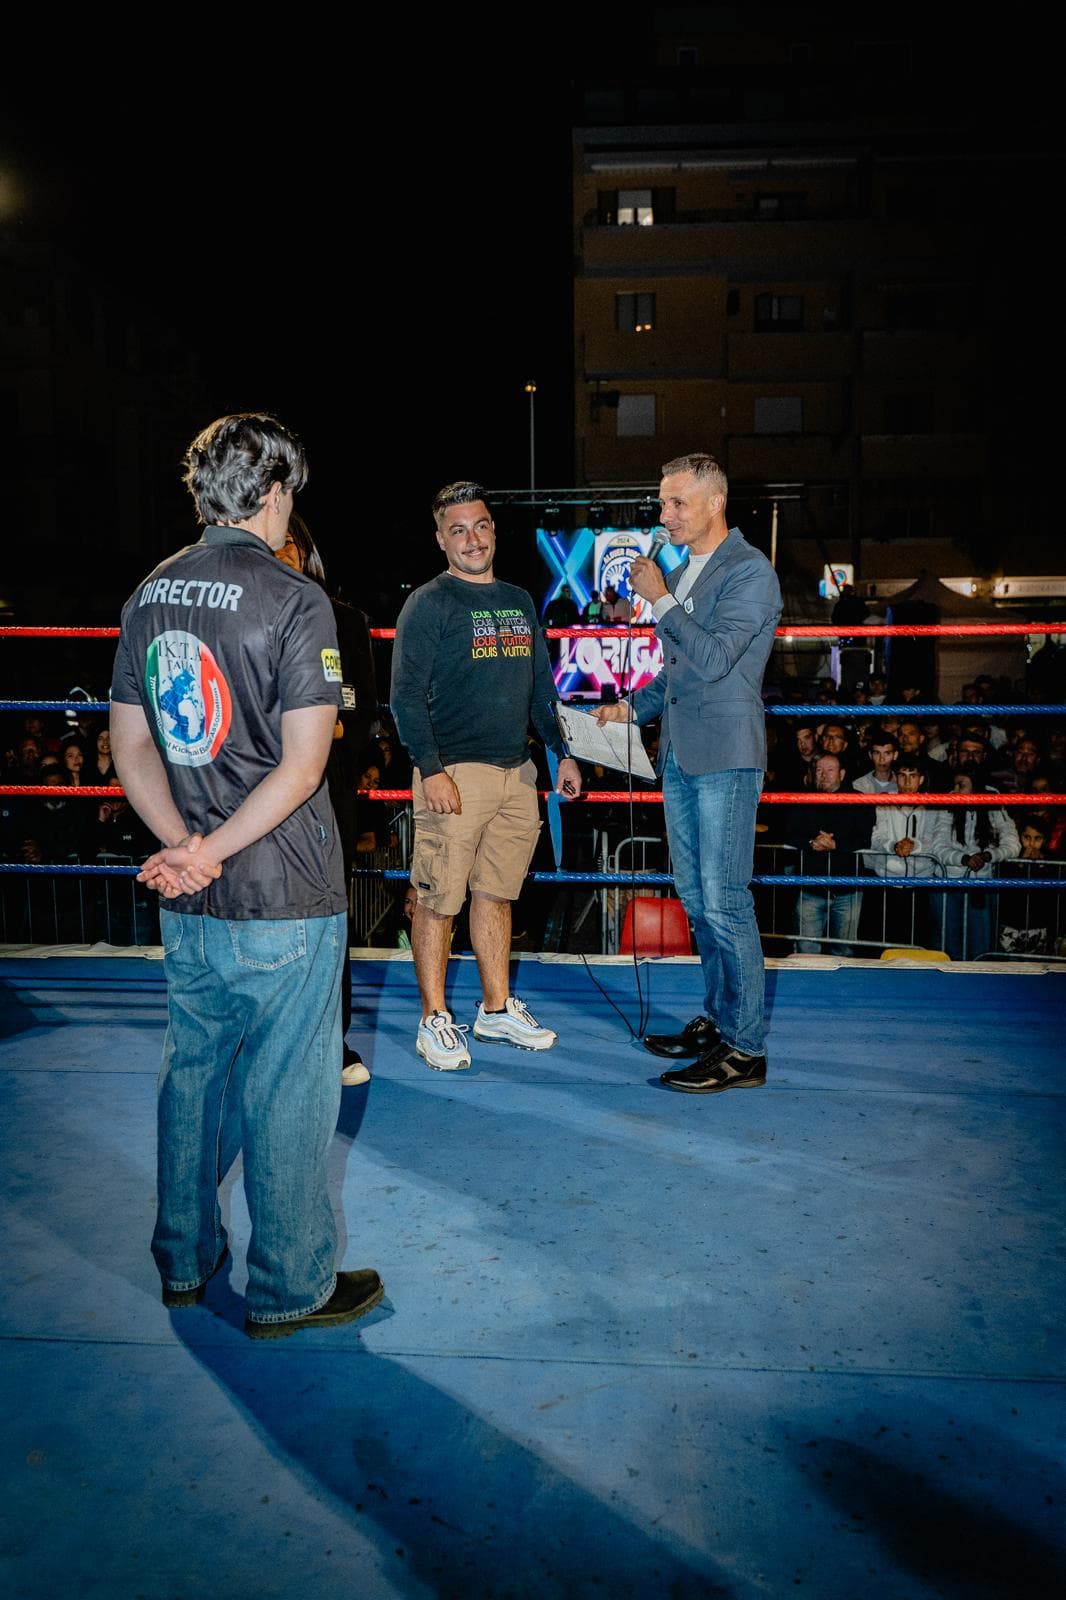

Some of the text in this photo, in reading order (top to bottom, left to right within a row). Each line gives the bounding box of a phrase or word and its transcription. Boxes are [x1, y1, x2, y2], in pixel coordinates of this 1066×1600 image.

[138, 578, 244, 611] DIRECTOR
[471, 608, 524, 619] LOUIS VUITTON
[472, 617, 528, 628] LOUIS VUITTON
[473, 626, 497, 637] LOUIS
[473, 635, 532, 647] LOUIS VUITTON
[472, 645, 532, 659] LOUIS VUITTON
